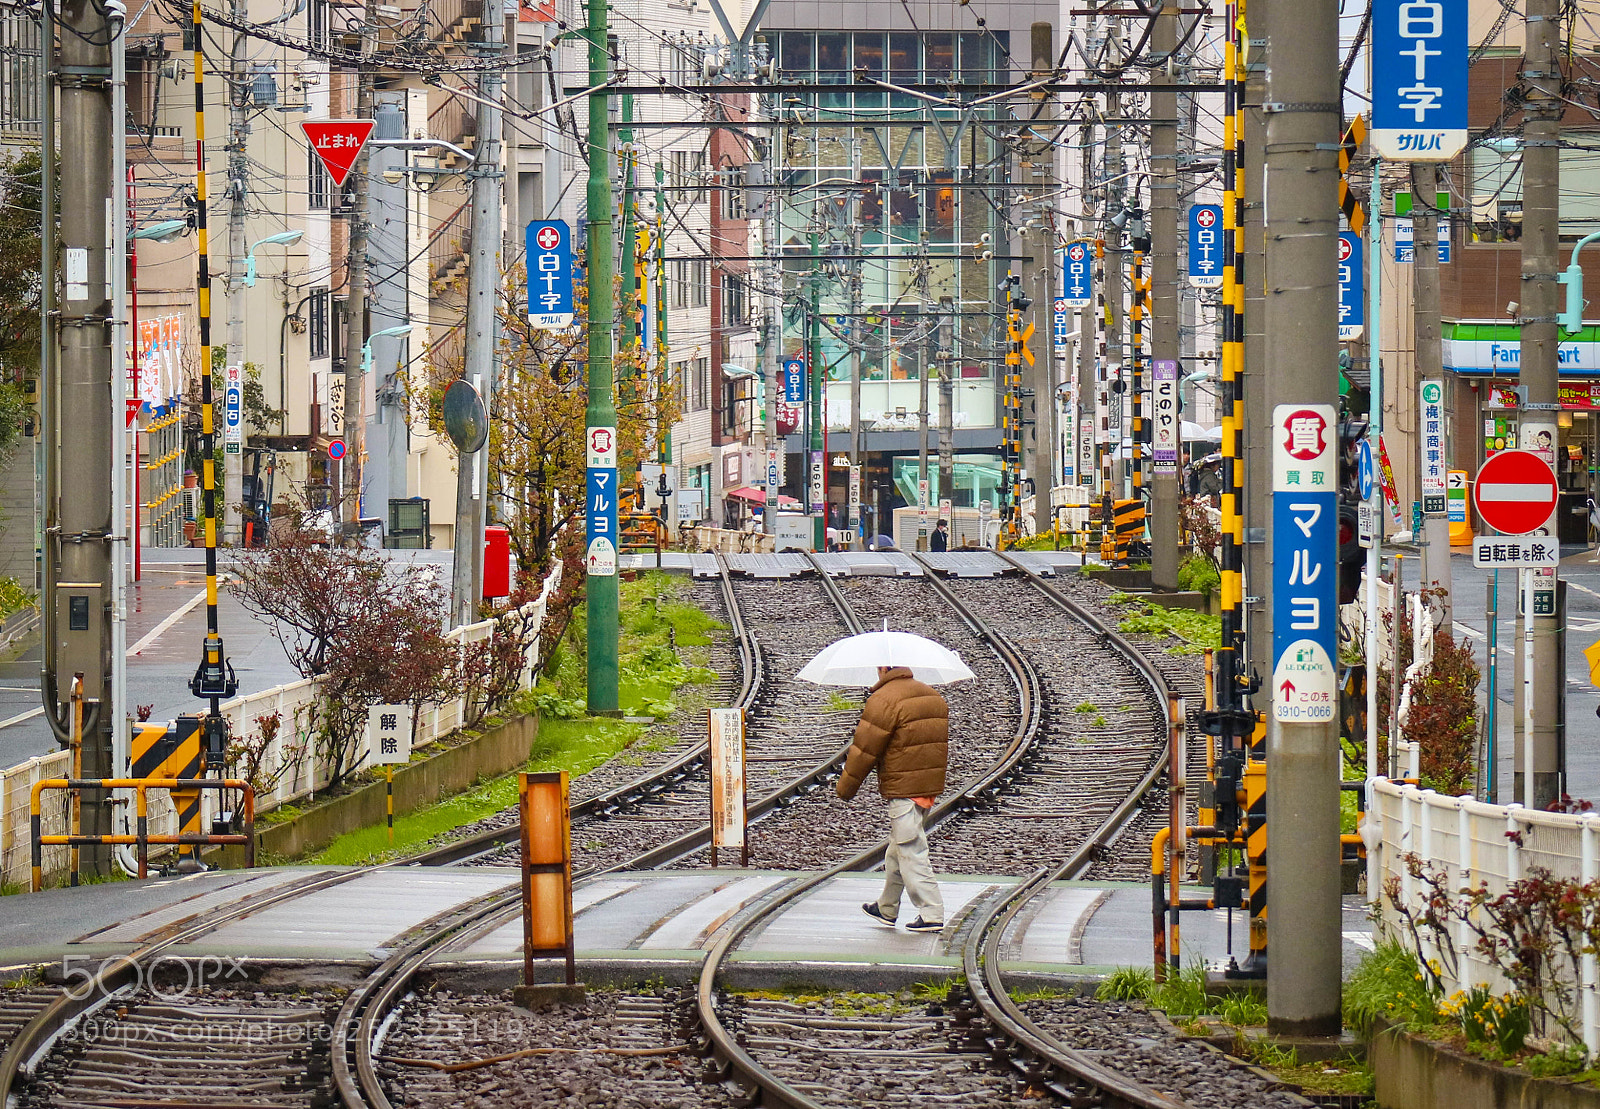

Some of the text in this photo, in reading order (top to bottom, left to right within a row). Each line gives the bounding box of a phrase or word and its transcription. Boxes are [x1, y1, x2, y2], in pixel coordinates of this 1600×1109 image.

[1398, 0, 1443, 122] 白十字
[316, 133, 360, 148] 止まれ
[1397, 133, 1445, 151] サルバ
[1197, 228, 1215, 275] 白十字
[538, 251, 561, 311] 白十字
[1070, 261, 1084, 298] 白十字
[1198, 277, 1216, 285] サルバ
[540, 314, 563, 325] サルバ
[789, 373, 800, 401] 白十字
[228, 393, 238, 420] 白石
[1159, 382, 1172, 426] さのや
[1082, 437, 1092, 460] さのや
[1425, 404, 1440, 476] 梶原商事有
[812, 464, 821, 490] さのや
[1286, 471, 1325, 485] 買取
[594, 472, 610, 533] マルヨ
[850, 484, 858, 503] さのや
[840, 531, 852, 542] 10
[1479, 543, 1555, 562] 自転車を除く
[1289, 503, 1322, 630] マルヨ
[1299, 692, 1330, 702] この先
[1277, 705, 1331, 717] 3910-0066
[380, 713, 398, 755] 解除
